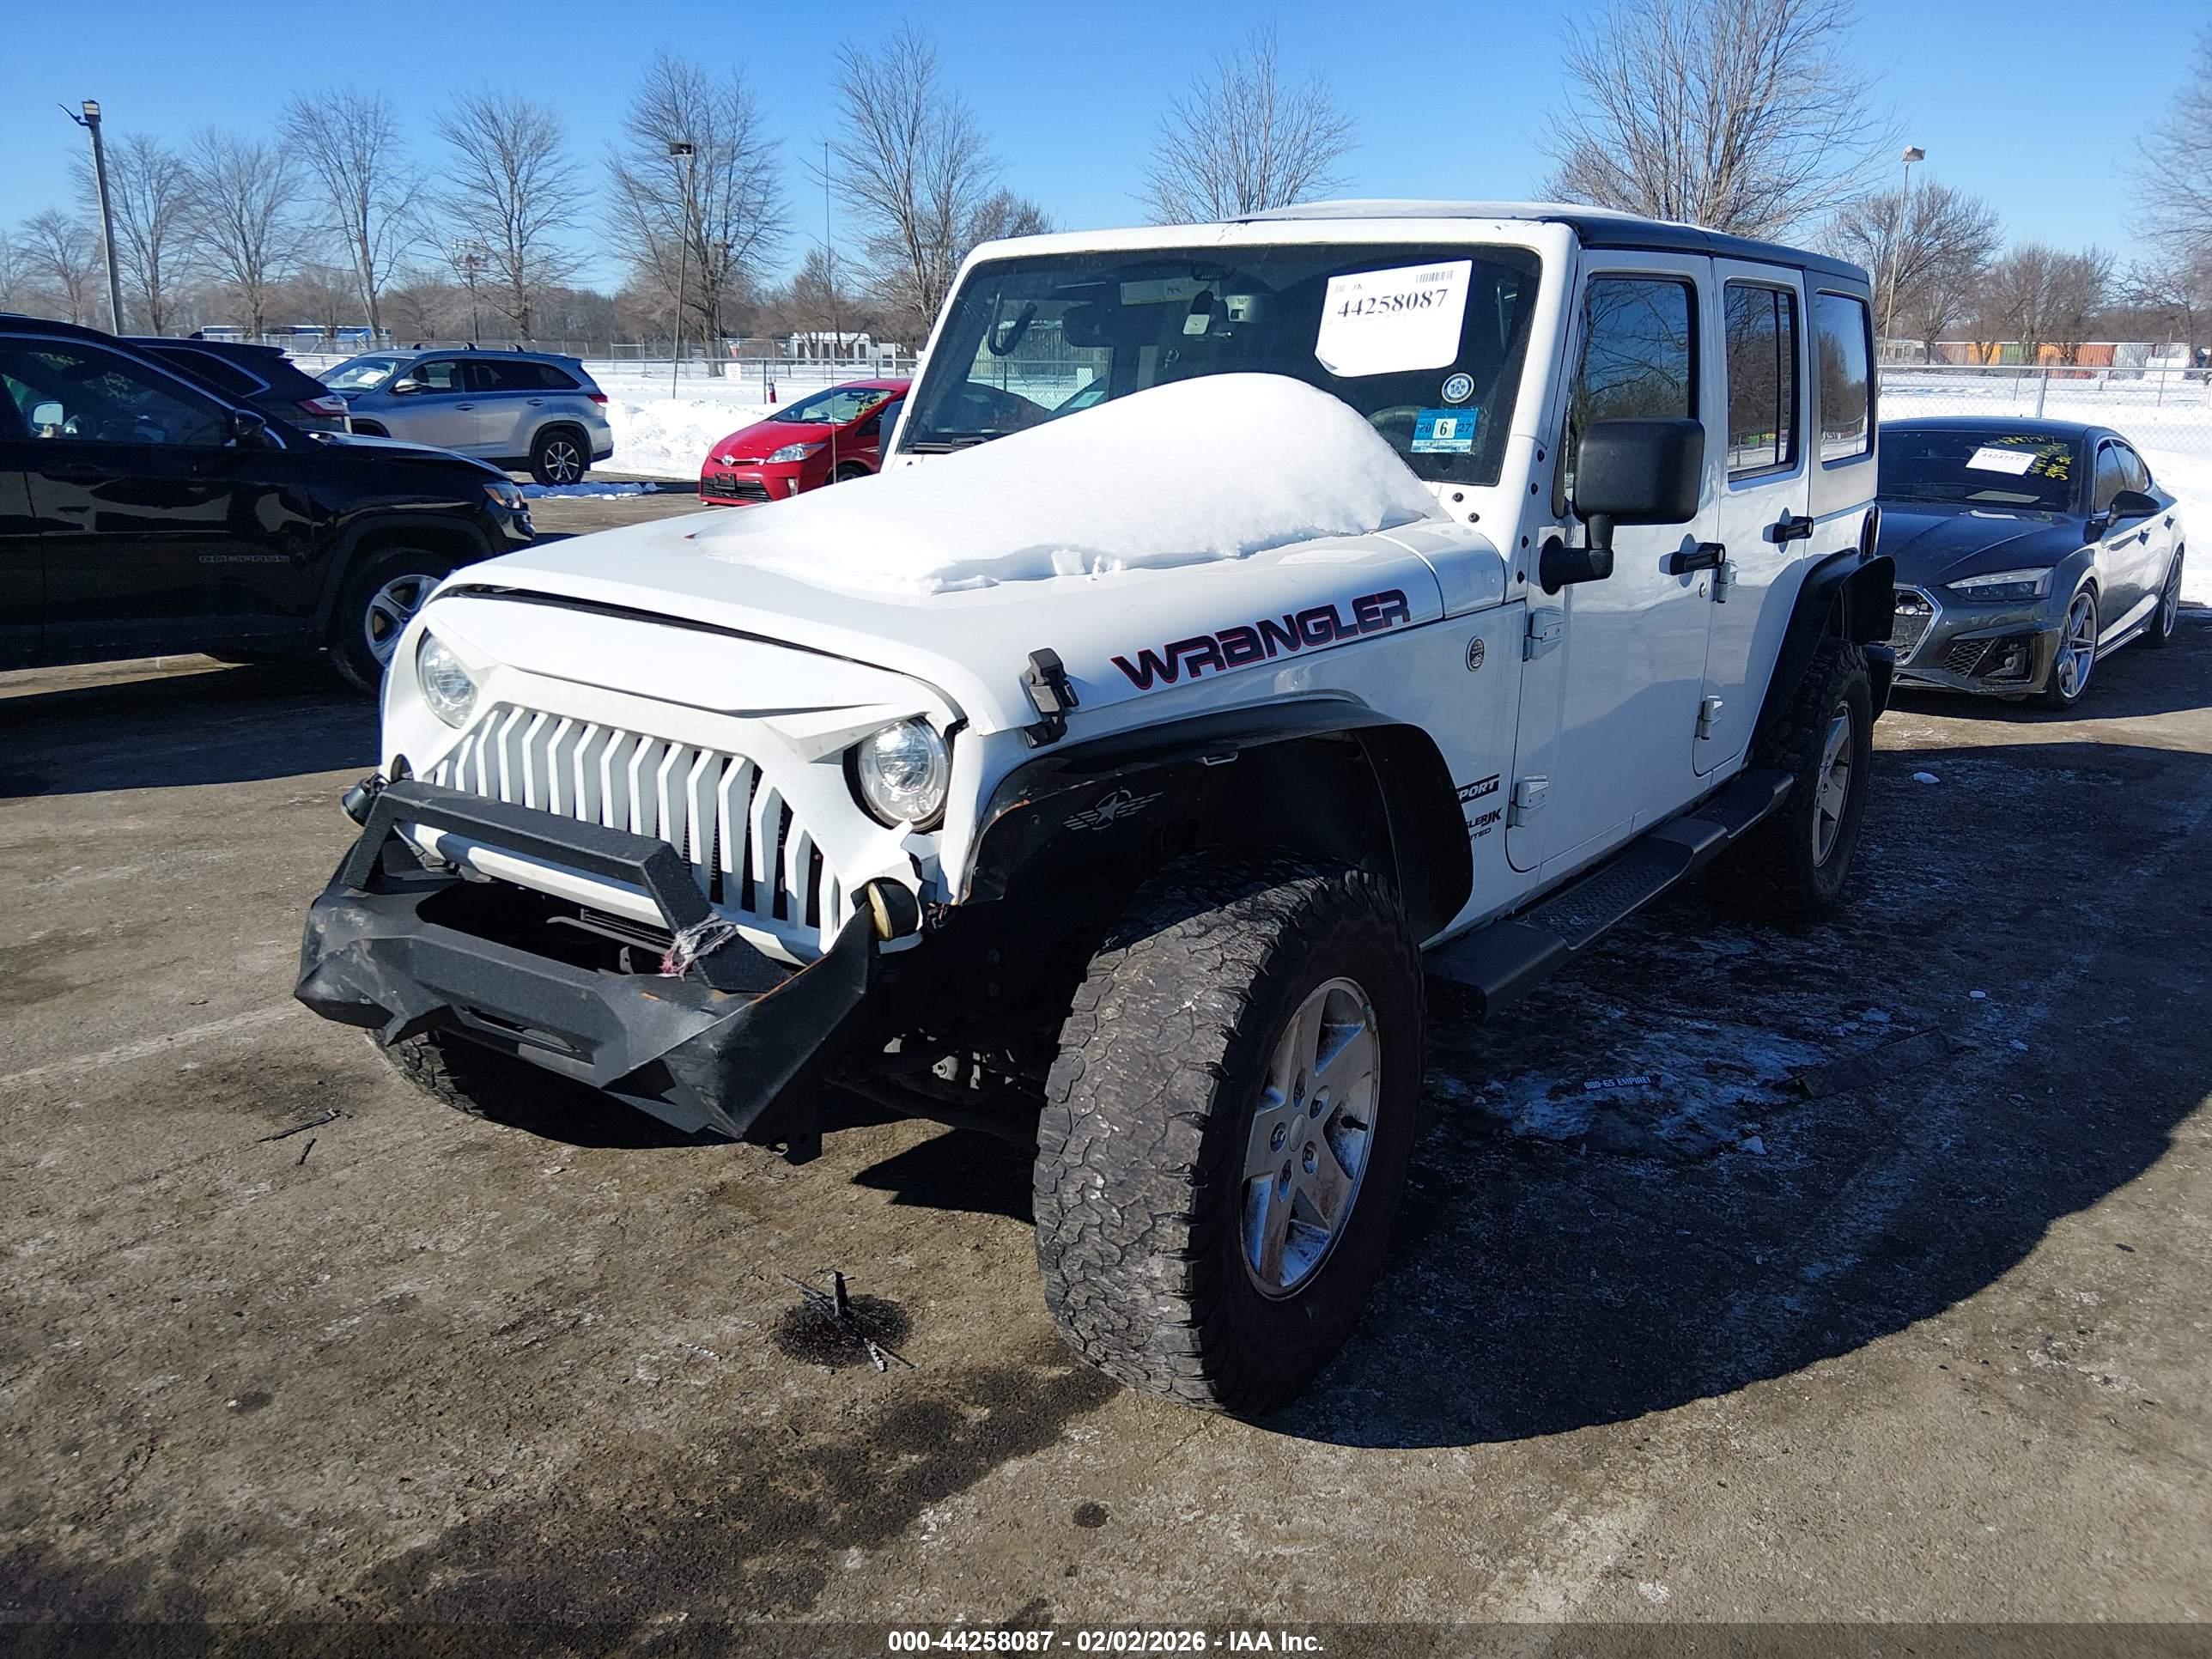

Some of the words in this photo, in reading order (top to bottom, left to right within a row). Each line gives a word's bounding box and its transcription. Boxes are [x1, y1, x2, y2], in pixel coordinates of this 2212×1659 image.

[1337, 288, 1449, 318] 44258087
[1439, 421, 1449, 436] 6
[1457, 422, 1472, 433] 27
[1110, 589, 1411, 690] WRANGLER
[1456, 778, 1499, 800] PORT
